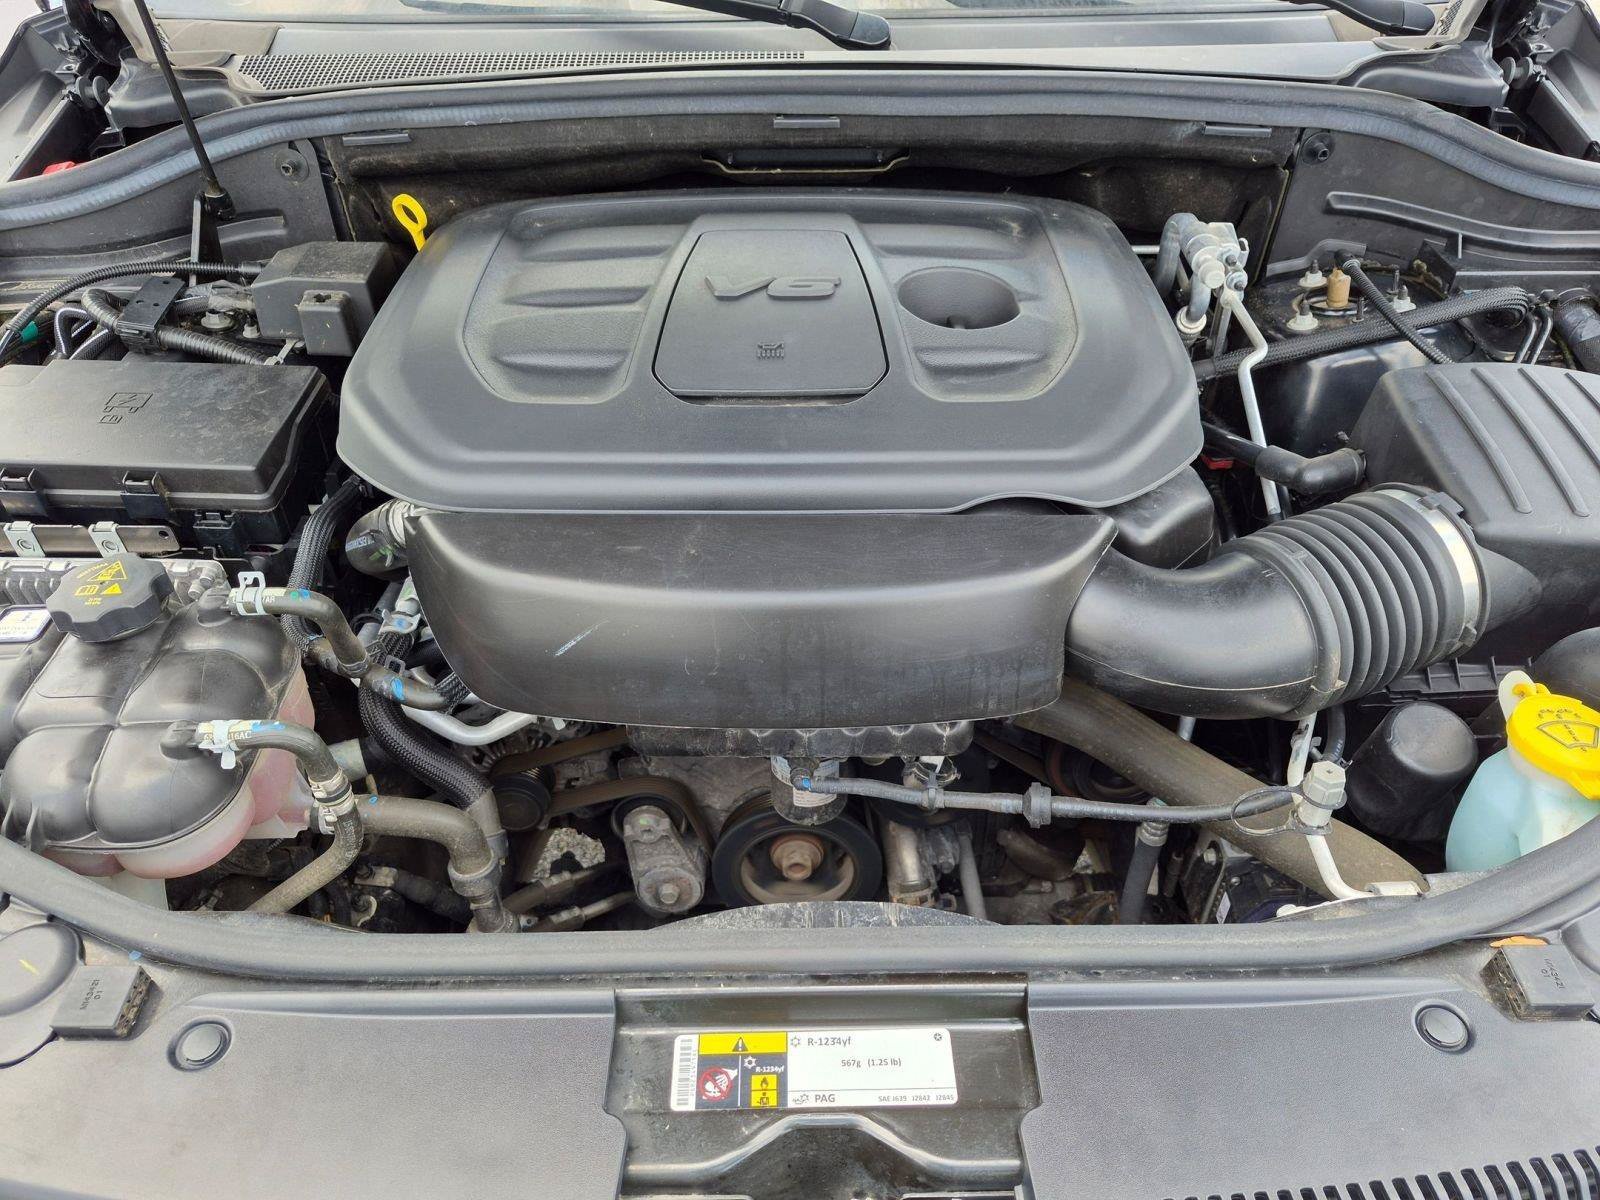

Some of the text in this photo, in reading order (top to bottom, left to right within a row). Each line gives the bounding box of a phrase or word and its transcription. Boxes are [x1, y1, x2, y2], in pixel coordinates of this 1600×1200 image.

[704, 275, 841, 302] V6
[807, 1036, 851, 1048] R-1234yf
[841, 1058, 902, 1069] 567g (1.25 lb)
[814, 1093, 836, 1104] PAG
